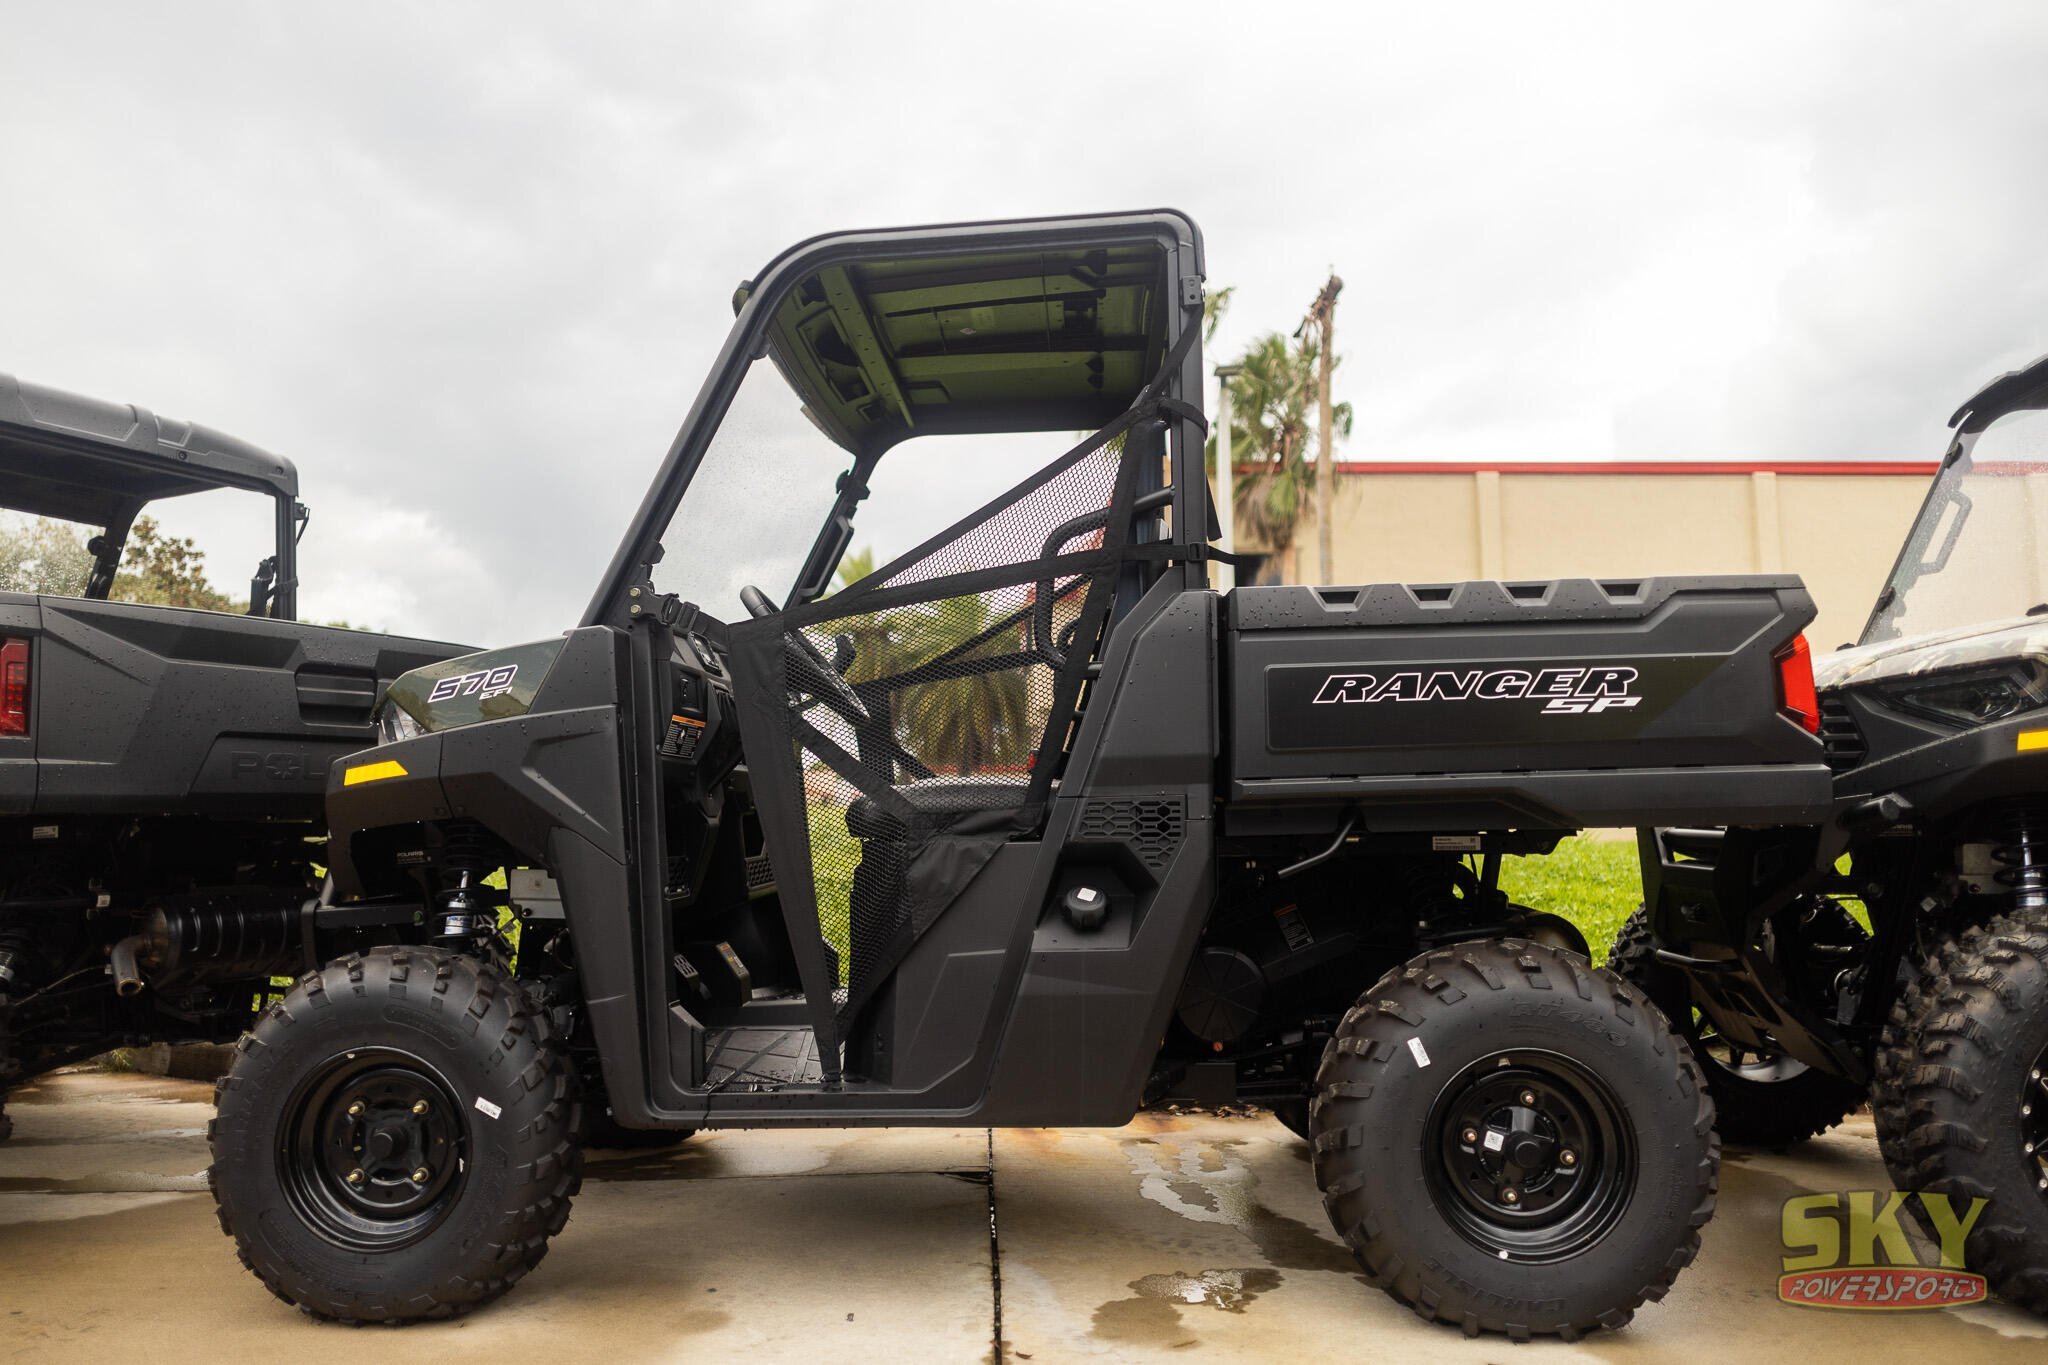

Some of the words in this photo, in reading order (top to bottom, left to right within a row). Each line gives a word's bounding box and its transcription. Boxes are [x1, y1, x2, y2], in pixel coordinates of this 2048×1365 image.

[427, 664, 519, 703] 570
[479, 686, 514, 701] EFI
[1312, 666, 1639, 704] RANGER
[1540, 697, 1643, 714] SP
